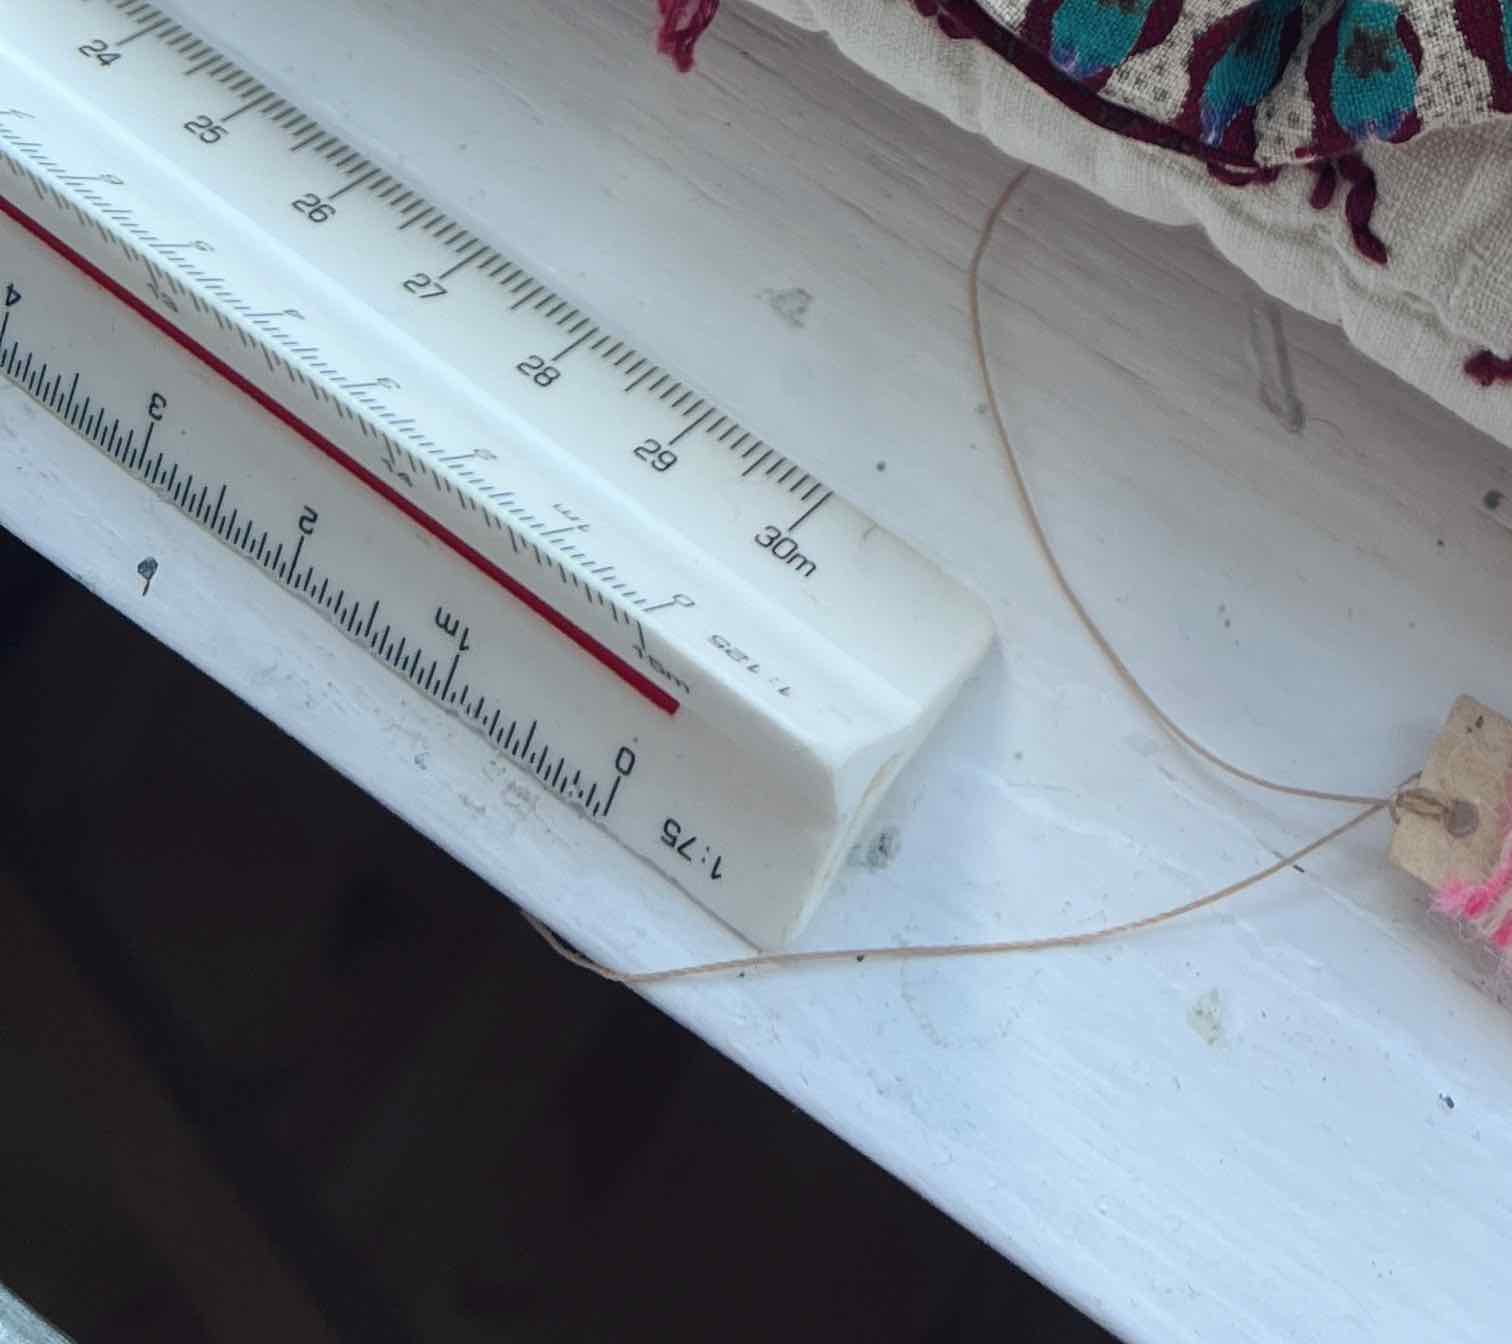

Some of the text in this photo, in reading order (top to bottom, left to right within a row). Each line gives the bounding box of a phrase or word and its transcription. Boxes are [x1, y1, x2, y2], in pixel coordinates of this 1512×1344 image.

[4, 282, 723, 881] 1:75 0 1m 2 3 4
[78, 39, 121, 66] 24
[183, 115, 229, 144] 25
[291, 193, 337, 223] 26
[402, 273, 448, 299] 27
[516, 355, 561, 388] 28
[633, 438, 678, 472] 29
[754, 525, 817, 577] 30m
